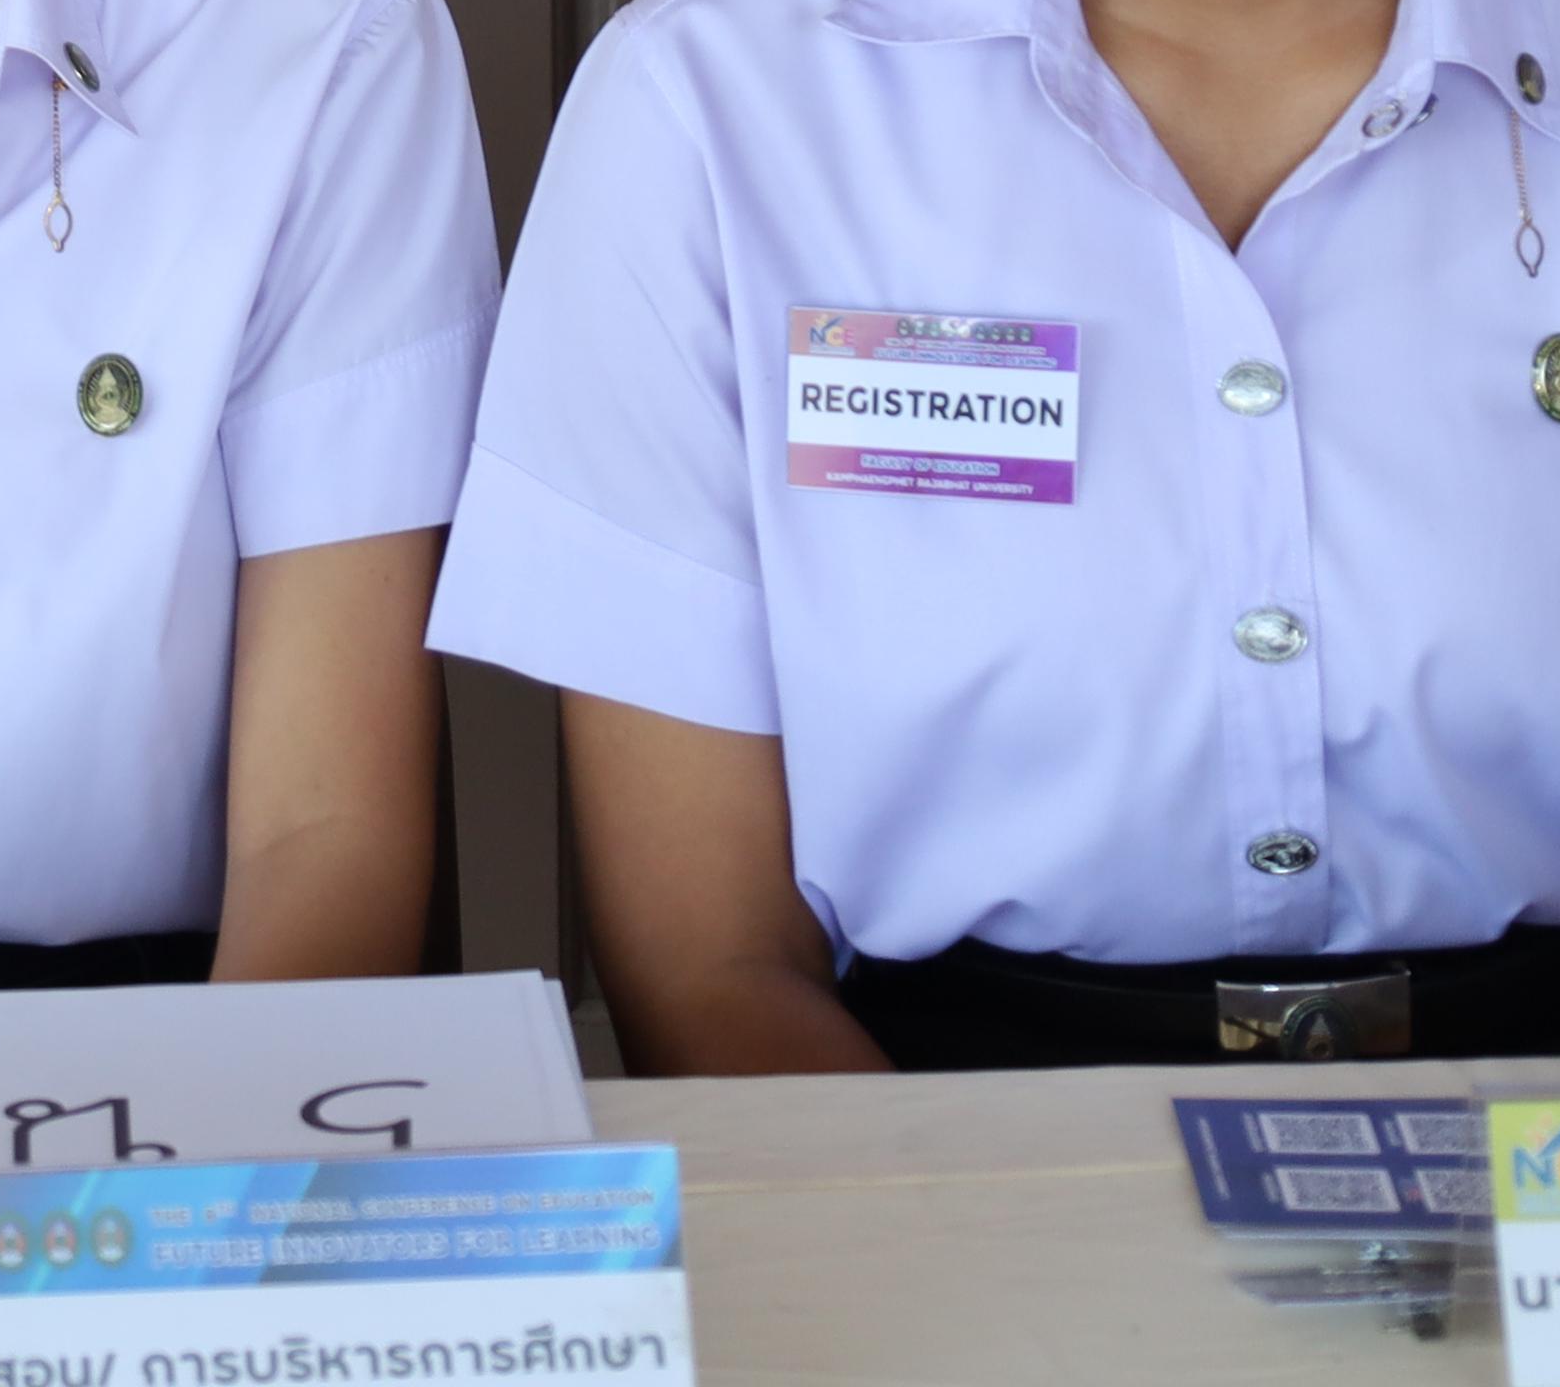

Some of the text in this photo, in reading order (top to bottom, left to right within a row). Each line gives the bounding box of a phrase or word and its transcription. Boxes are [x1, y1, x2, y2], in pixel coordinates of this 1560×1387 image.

[802, 383, 1063, 427] REGISTRATION
[151, 1224, 662, 1269] FUTURE INNOVATORS FOR LEARNING
